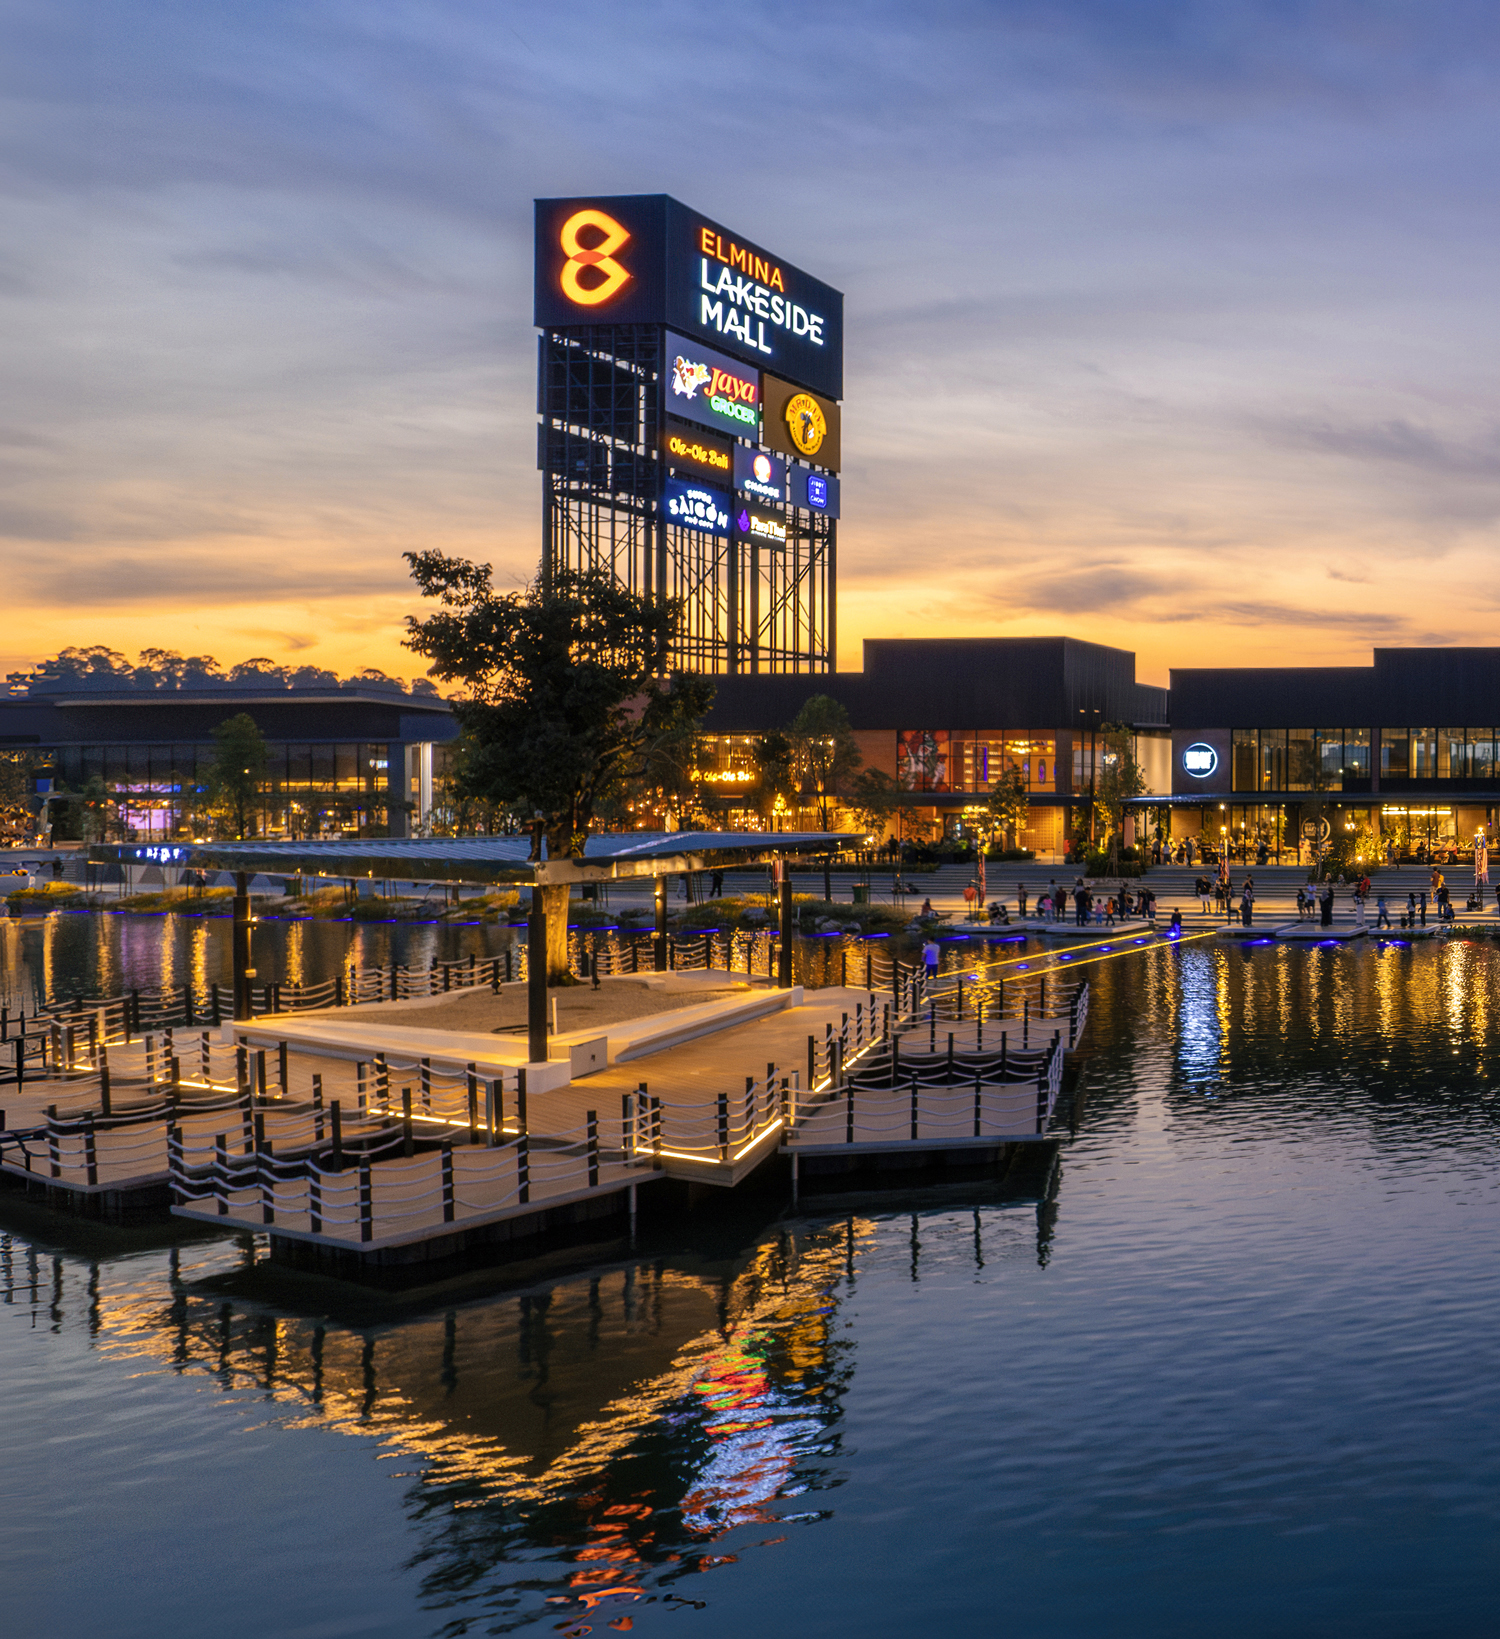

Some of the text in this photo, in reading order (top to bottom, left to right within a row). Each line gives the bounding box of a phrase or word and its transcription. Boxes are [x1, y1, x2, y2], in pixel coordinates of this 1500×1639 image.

[701, 227, 785, 293] ELMINA
[701, 257, 825, 346] LAKESIDE
[701, 293, 772, 355] MALL
[703, 367, 756, 403] Jaya
[710, 395, 756, 426] GROCER
[708, 450, 729, 470] Bali
[744, 480, 780, 498] CHAGEE
